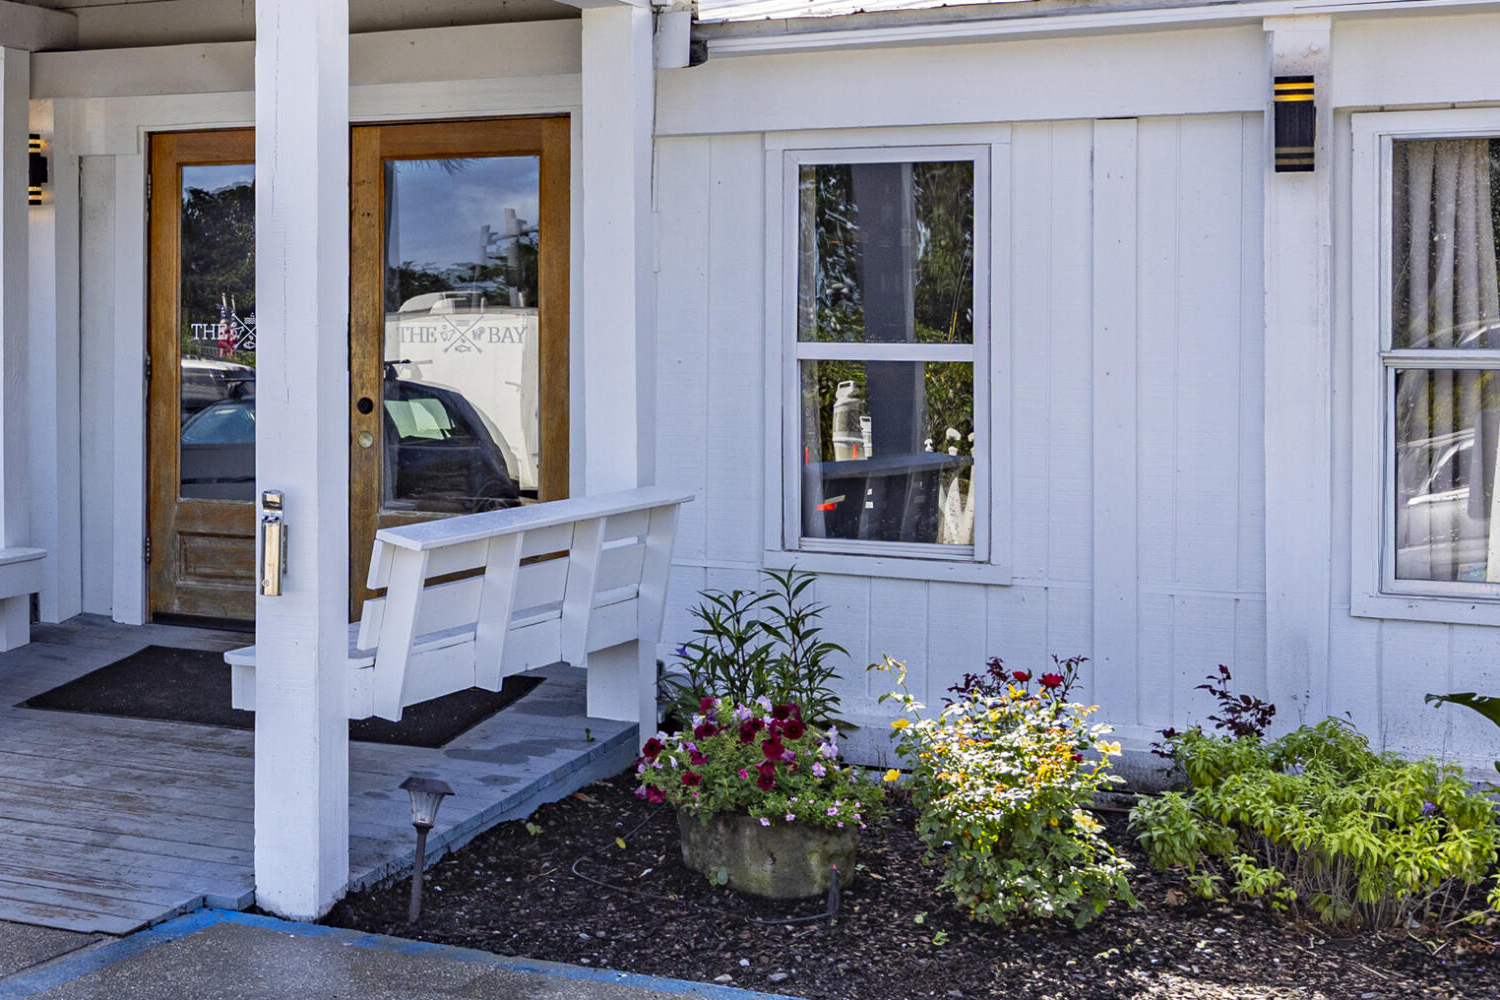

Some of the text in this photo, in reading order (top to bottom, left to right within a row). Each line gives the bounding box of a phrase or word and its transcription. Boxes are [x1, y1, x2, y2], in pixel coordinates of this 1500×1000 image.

[191, 323, 228, 340] THE
[396, 326, 528, 344] THE BAY
